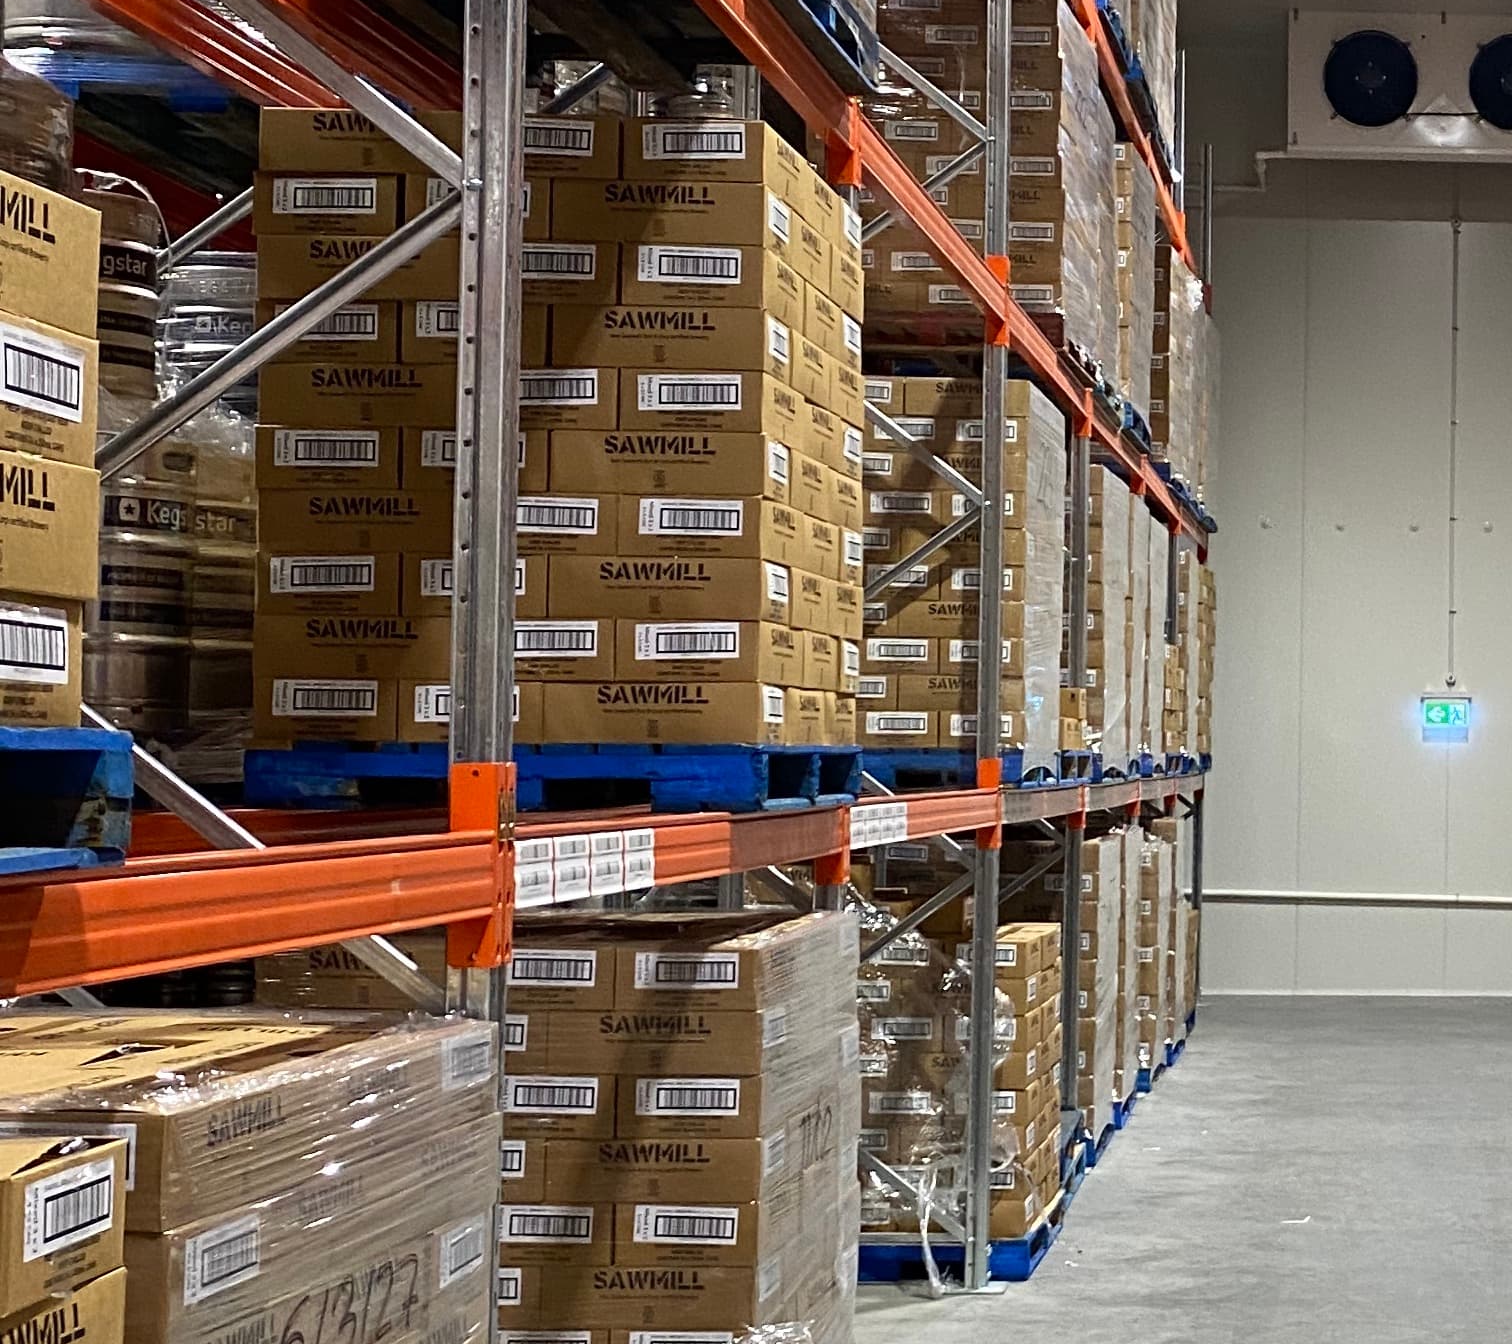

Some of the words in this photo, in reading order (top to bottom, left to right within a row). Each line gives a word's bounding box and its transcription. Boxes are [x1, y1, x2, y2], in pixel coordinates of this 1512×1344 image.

[604, 184, 716, 205] SAWMILL
[0, 186, 56, 245] MILL
[102, 256, 148, 277] gstar
[604, 311, 716, 331] SAWMILL
[311, 368, 423, 389] SAWMILL
[604, 435, 716, 455] SAWMILL
[0, 461, 56, 512] MILL
[147, 500, 187, 531] Kegs
[309, 497, 421, 517] SAWMILL
[195, 511, 236, 533] star
[600, 562, 711, 582] SAWMILL
[306, 619, 418, 639] SAWMILL
[597, 686, 709, 705] SAWMILL
[600, 1015, 711, 1035] SAWMILL
[600, 1143, 710, 1163] SAWMILL
[594, 1271, 705, 1290] SAWMILL
